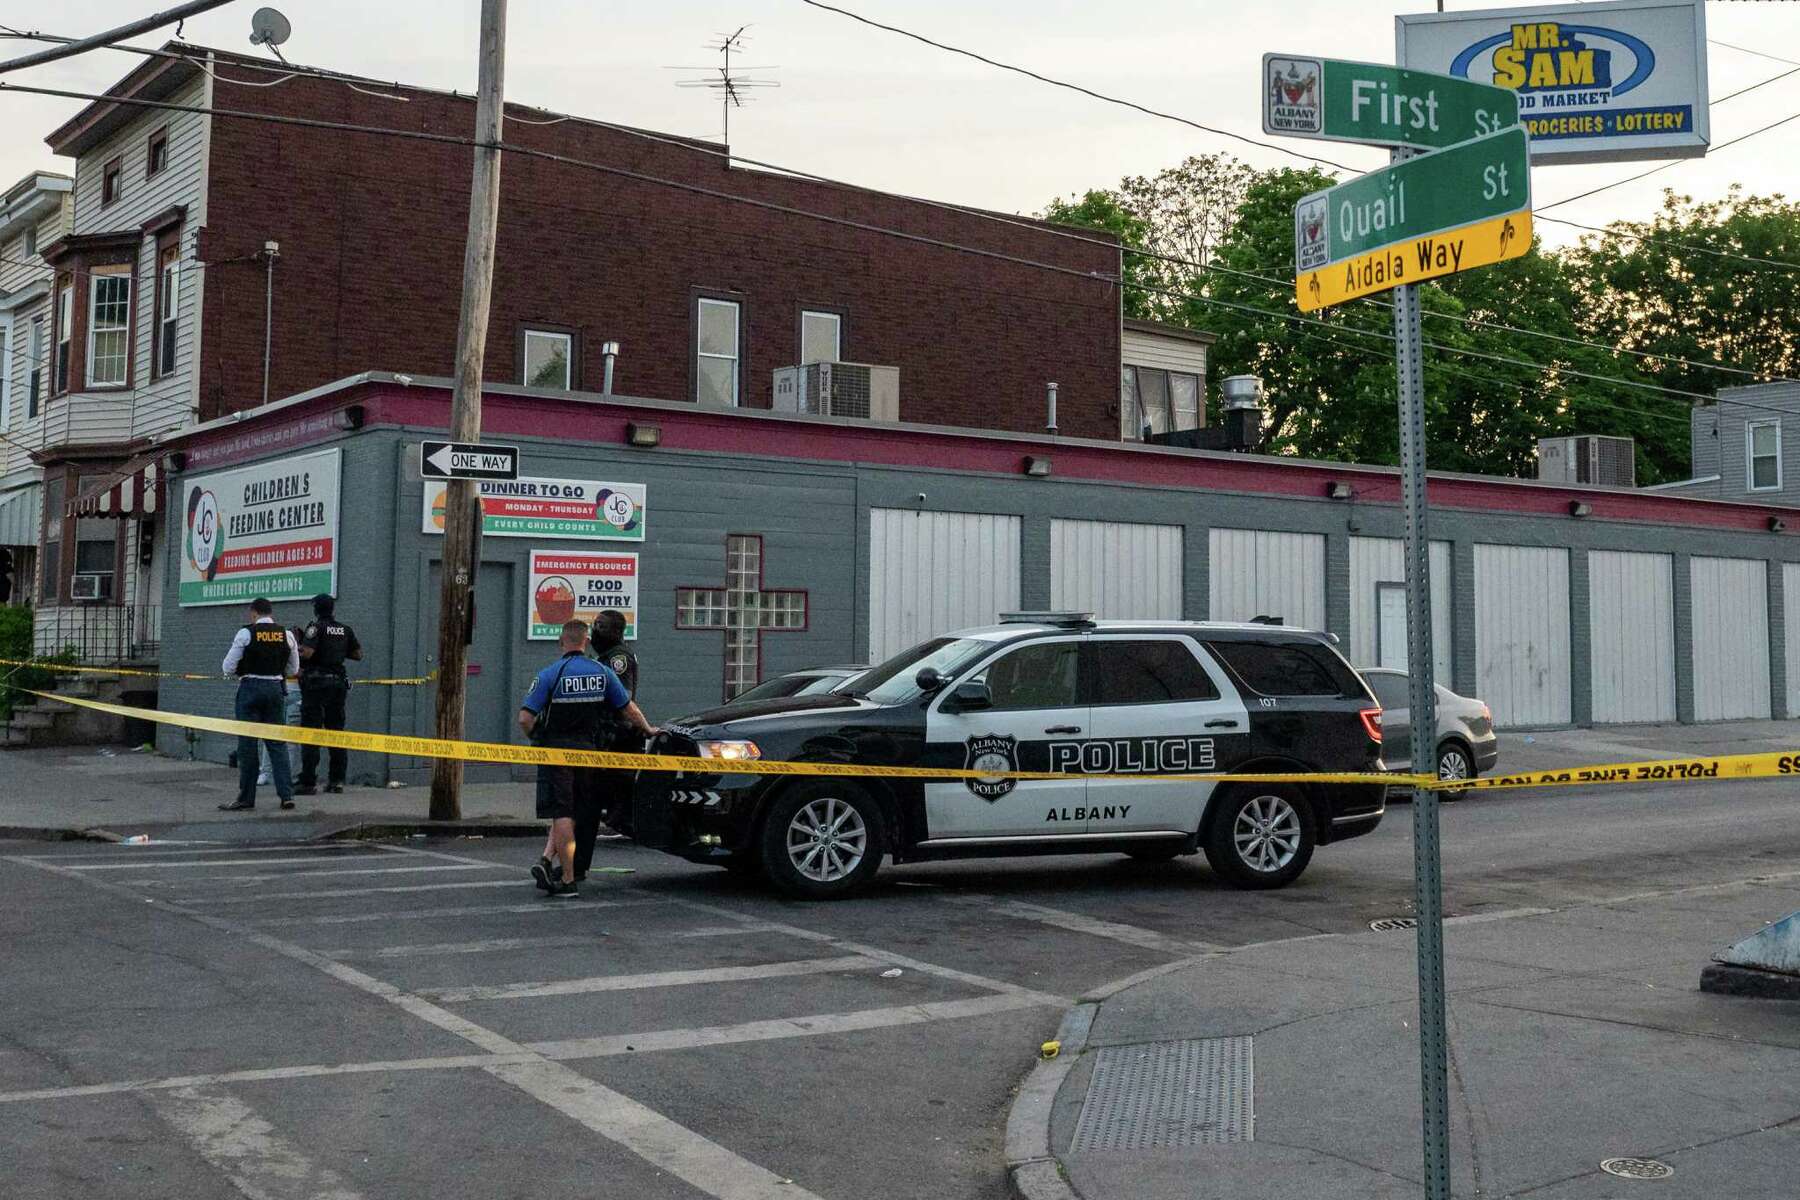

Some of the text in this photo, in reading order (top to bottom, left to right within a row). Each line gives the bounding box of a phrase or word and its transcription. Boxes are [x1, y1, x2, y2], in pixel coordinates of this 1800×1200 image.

[1511, 22, 1569, 50] MR.
[1492, 45, 1596, 90] SAM
[1352, 79, 1502, 137] First St
[1542, 92, 1610, 108] MARKET
[1274, 107, 1316, 120] ALBANY
[1273, 118, 1316, 130] NEW YORK
[1527, 112, 1684, 136] ROCERIES LOTTERY
[1340, 162, 1510, 242] Quail St
[1345, 239, 1464, 293] Aidala Way
[451, 453, 508, 470] ONE WAY
[480, 482, 584, 498] DINNER TO GO
[505, 503, 544, 512] MONDAY
[550, 505, 594, 515] THURSDAY
[230, 502, 324, 536] FEEDING CENTER
[494, 519, 596, 532] EVERY CHILD COUNTS
[223, 544, 324, 569] FEEDING CHILDREN AGES 2-18
[536, 560, 632, 571] EMERGENCY RESOURCE
[202, 577, 303, 598] WHERE EVERY CHILD COUNTS
[587, 580, 623, 590] FOOD
[578, 595, 631, 606] PANTRY
[256, 632, 284, 642] POLICE
[326, 626, 345, 636] POLICE
[565, 676, 603, 692] POLICE
[1259, 697, 1277, 707] 107
[971, 739, 1012, 751] ALBANY
[1049, 738, 1216, 774] POLICE
[1578, 768, 1630, 782] LINE
[1636, 761, 1719, 780] POLICE
[972, 781, 1011, 794] POLICE
[1046, 804, 1133, 822] ALBANY
